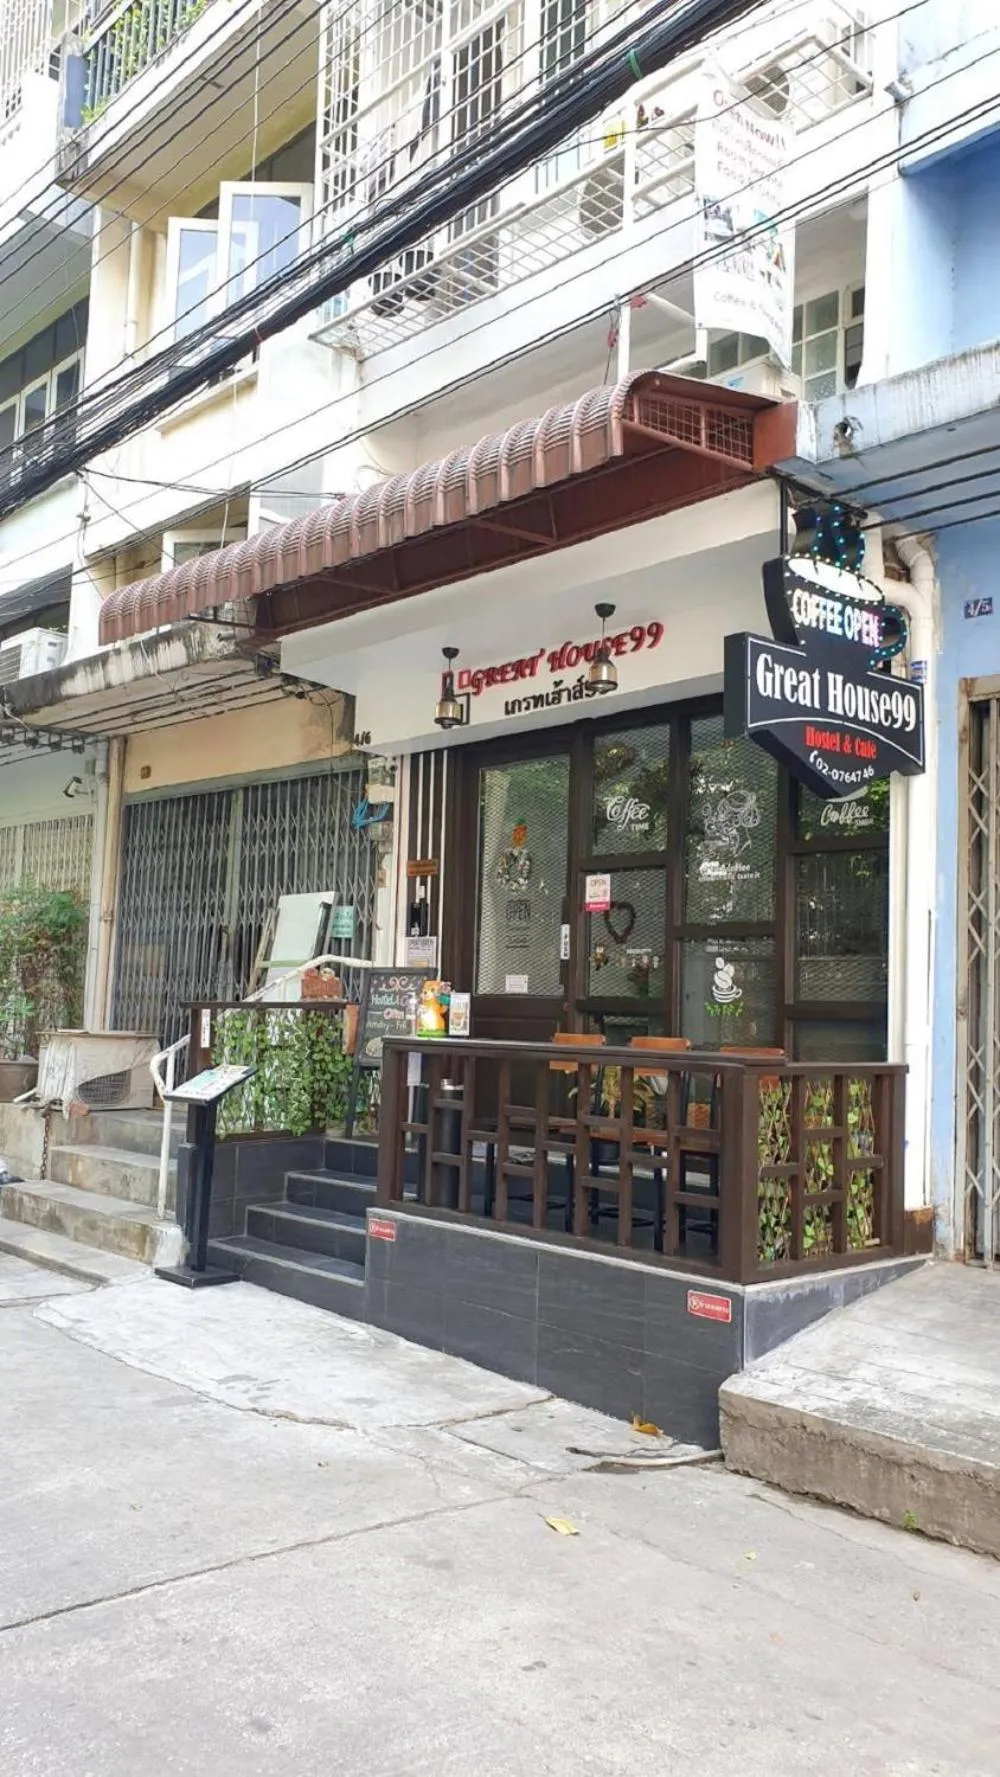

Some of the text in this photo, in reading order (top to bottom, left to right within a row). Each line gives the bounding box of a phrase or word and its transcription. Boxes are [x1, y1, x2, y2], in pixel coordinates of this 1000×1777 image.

[792, 587, 880, 648] COFFEE OPEN
[471, 647, 546, 697] GREAT
[756, 653, 821, 710] Great
[827, 672, 916, 732] House99
[805, 725, 841, 753] Hostel
[843, 734, 853, 754] &
[815, 757, 875, 784] 02-0764746
[604, 796, 650, 831] Coffee
[820, 801, 870, 826] Coffee
